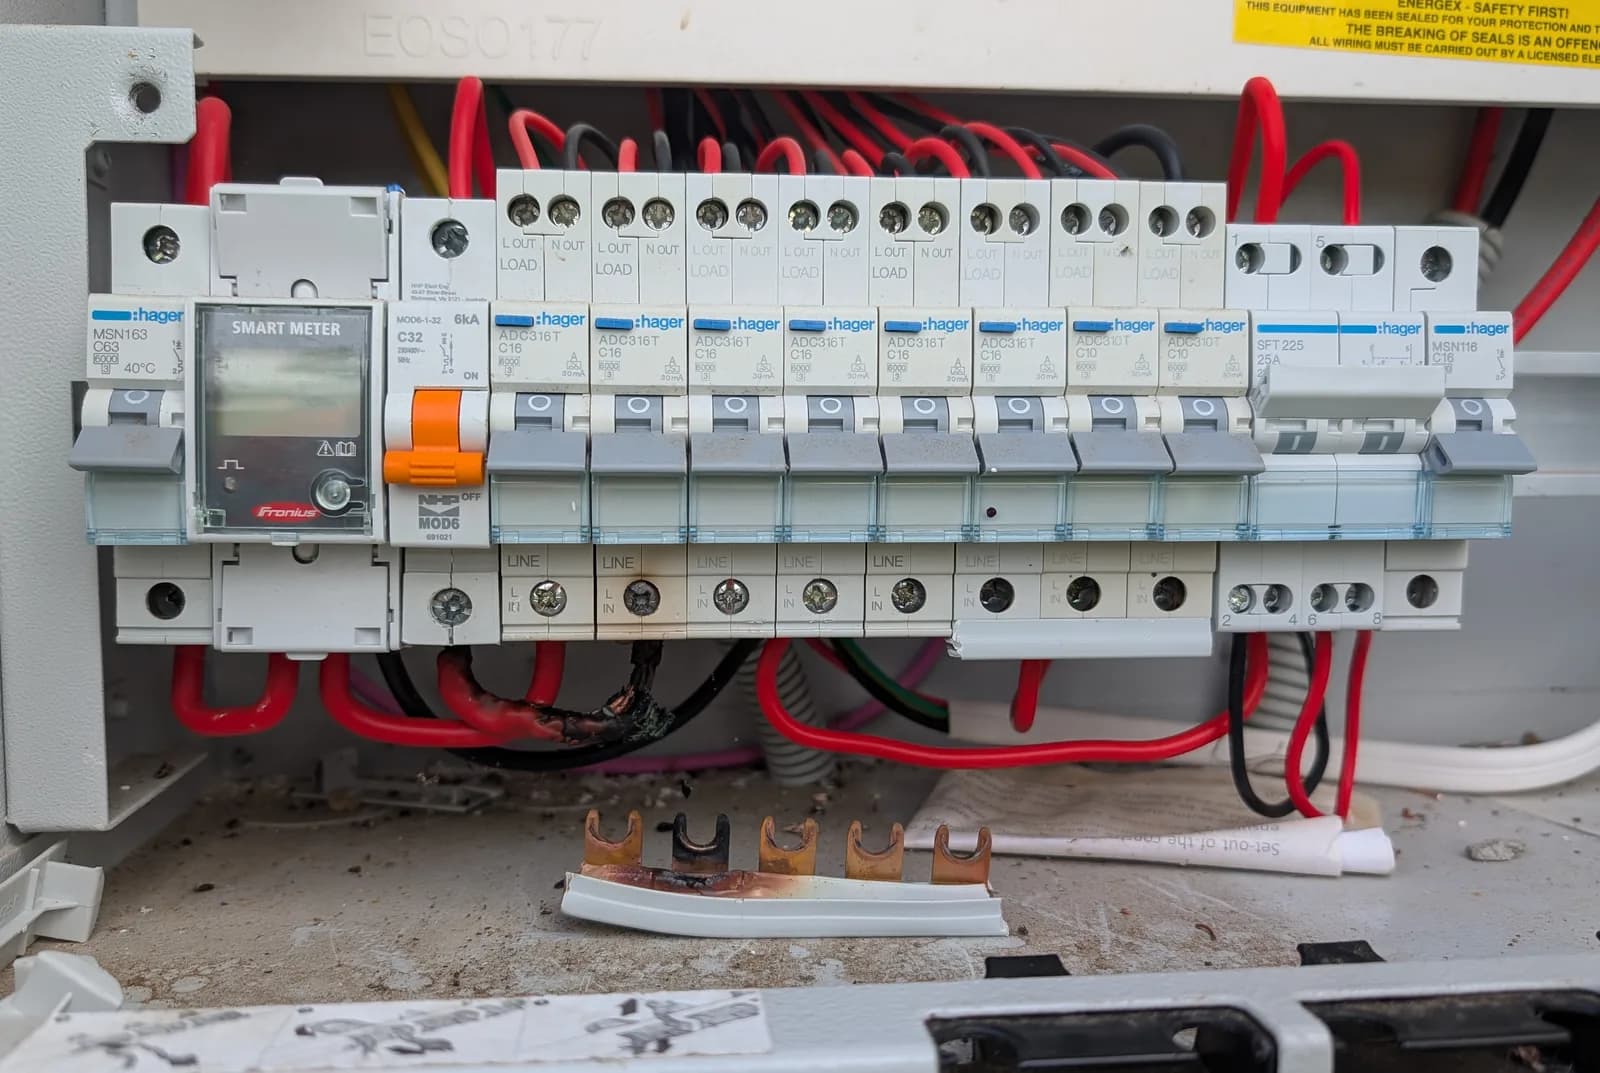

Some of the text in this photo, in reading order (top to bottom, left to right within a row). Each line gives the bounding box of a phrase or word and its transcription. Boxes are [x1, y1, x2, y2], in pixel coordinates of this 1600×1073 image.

[1397, 0, 1461, 12] ENERGEX
[1474, 2, 1524, 16] SAFETY
[1528, 6, 1569, 19] FIRST!
[1246, 1, 1270, 11] THIS
[1273, 3, 1336, 17] EQUIPMENT
[1339, 8, 1361, 19] HAS
[1364, 10, 1393, 21] BEEN
[1396, 12, 1438, 24] SEALED
[1441, 15, 1463, 25] FOR
[1467, 16, 1496, 27] YOUR
[1500, 19, 1567, 33] PROTECTION
[1570, 24, 1592, 34] AND
[1346, 23, 1371, 36] THE
[1376, 26, 1445, 41] BREAKING
[1450, 30, 1468, 42] OF
[1471, 32, 1514, 46] SEALS
[1518, 36, 1530, 47] IS
[1534, 37, 1551, 47] AN
[1309, 37, 1329, 47] ALL
[1333, 38, 1371, 50] WIRING
[1375, 40, 1404, 51] MUST
[1407, 42, 1422, 52] BE
[1425, 44, 1472, 56] CARRIED
[1475, 47, 1497, 57] OUT
[1500, 49, 1513, 58] BY
[1517, 50, 1525, 59] A
[1527, 51, 1579, 63] LICENSED
[503, 238, 536, 249] L OUT
[551, 240, 585, 251] N OUT
[1232, 234, 1239, 246] 1
[1315, 235, 1326, 248] 5
[598, 243, 631, 254] L OUT
[646, 245, 680, 255] N OUT
[875, 247, 907, 257] L OUT
[921, 248, 953, 258] N OUT
[500, 258, 537, 272] LOAD
[596, 263, 632, 276] LOAD
[690, 264, 728, 277] LOAD
[782, 266, 819, 279] LOAD
[872, 266, 907, 279] LOAD
[454, 313, 480, 325] 6kA
[232, 320, 341, 336] SMART METER
[93, 328, 148, 340] MSN163
[398, 331, 423, 343] C32
[599, 335, 659, 346] ADC316T
[695, 336, 751, 347] ADC316T
[791, 337, 846, 348] ADC316T
[1257, 339, 1304, 351] SFT 225
[93, 340, 119, 353] C63
[499, 342, 522, 353] C16
[1432, 341, 1477, 352] MSN116
[599, 347, 622, 358] C16
[695, 348, 717, 359] C16
[791, 349, 812, 360] C16
[888, 349, 909, 360] C16
[1076, 347, 1097, 358] C10
[1168, 348, 1188, 359] C10
[1432, 352, 1454, 363] C16
[1257, 354, 1281, 365] 25A
[124, 362, 156, 374] 40°C
[463, 372, 479, 380] ON
[461, 492, 481, 501] OFF
[257, 506, 317, 518] Fronius
[419, 517, 460, 529] MOD6
[507, 555, 540, 567] LINE
[603, 556, 634, 569] LINE
[697, 556, 728, 569] LINE
[784, 556, 815, 568] LINE
[873, 555, 904, 567] LINE
[511, 588, 518, 598] L
[606, 589, 612, 599] L
[874, 587, 881, 597] L
[508, 602, 520, 612] IN
[603, 603, 614, 614] IN
[697, 598, 708, 609] IN
[784, 598, 795, 609] IN
[871, 601, 882, 611] IN
[1222, 614, 1231, 627] 2
[1288, 614, 1297, 625] 4
[1307, 614, 1317, 625] 6
[1372, 612, 1382, 625] 8
[1167, 836, 1195, 850] the
[1200, 838, 1216, 852] of
[1223, 839, 1281, 856] Set-out
